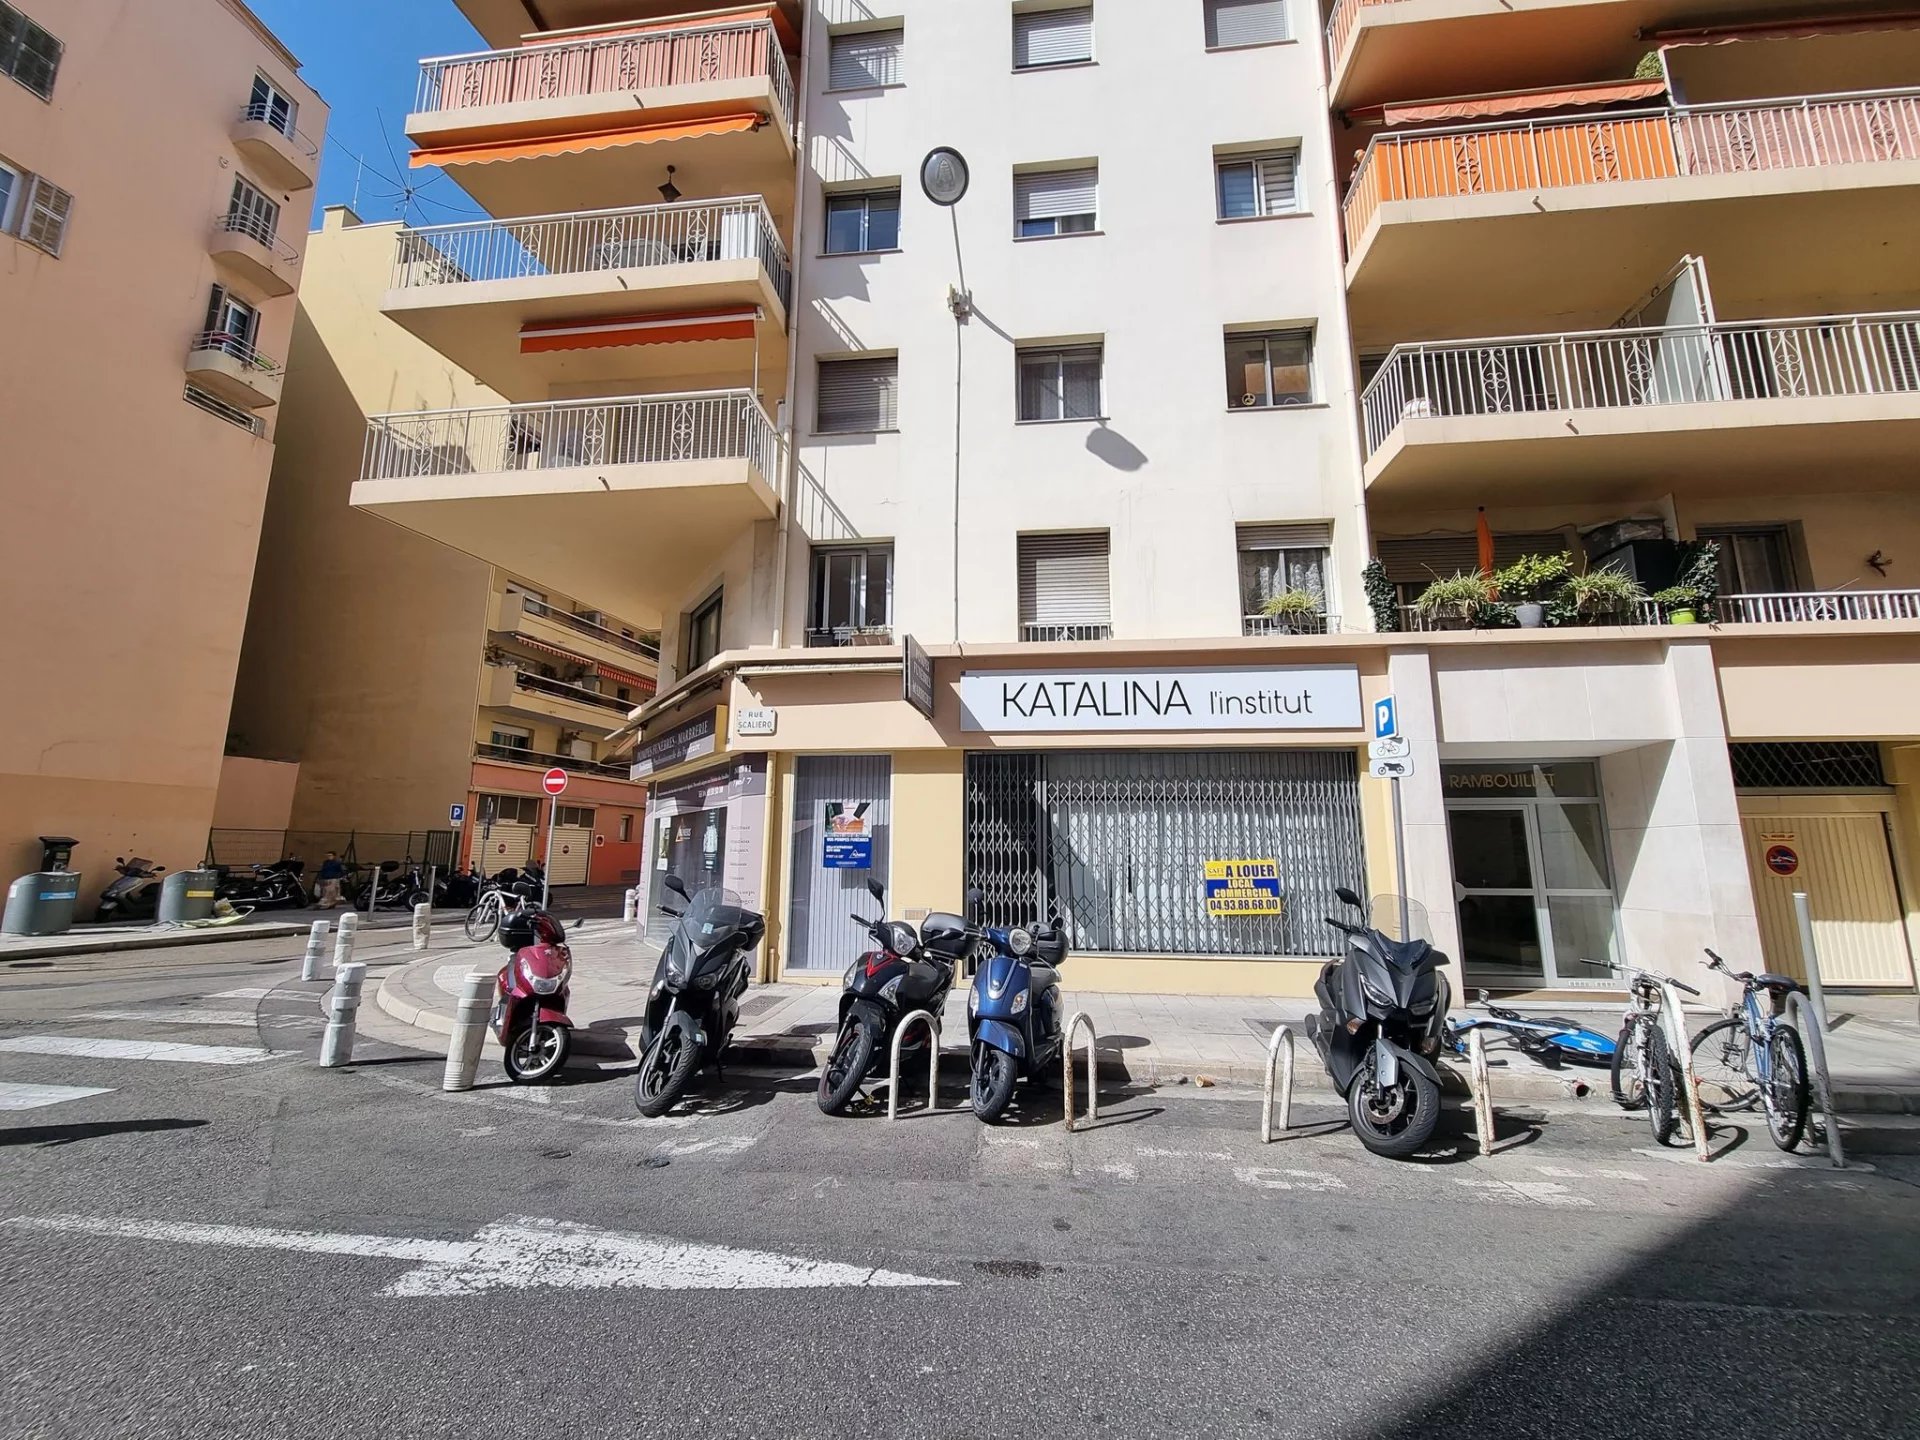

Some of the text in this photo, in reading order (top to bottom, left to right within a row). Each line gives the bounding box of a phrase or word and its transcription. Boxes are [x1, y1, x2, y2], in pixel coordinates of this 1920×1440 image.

[1003, 680, 1313, 717] KATALINA l'institut
[1378, 705, 1389, 731] P
[738, 720, 773, 729] SCALIERO
[1448, 773, 1555, 788] RAMBOUILLT
[453, 807, 461, 818] P
[1226, 864, 1275, 877] A LOUER
[1227, 879, 1255, 888] LOCAL
[1214, 888, 1273, 898] COMMERCIAL
[1210, 899, 1278, 911] 04.93.88.68.00
